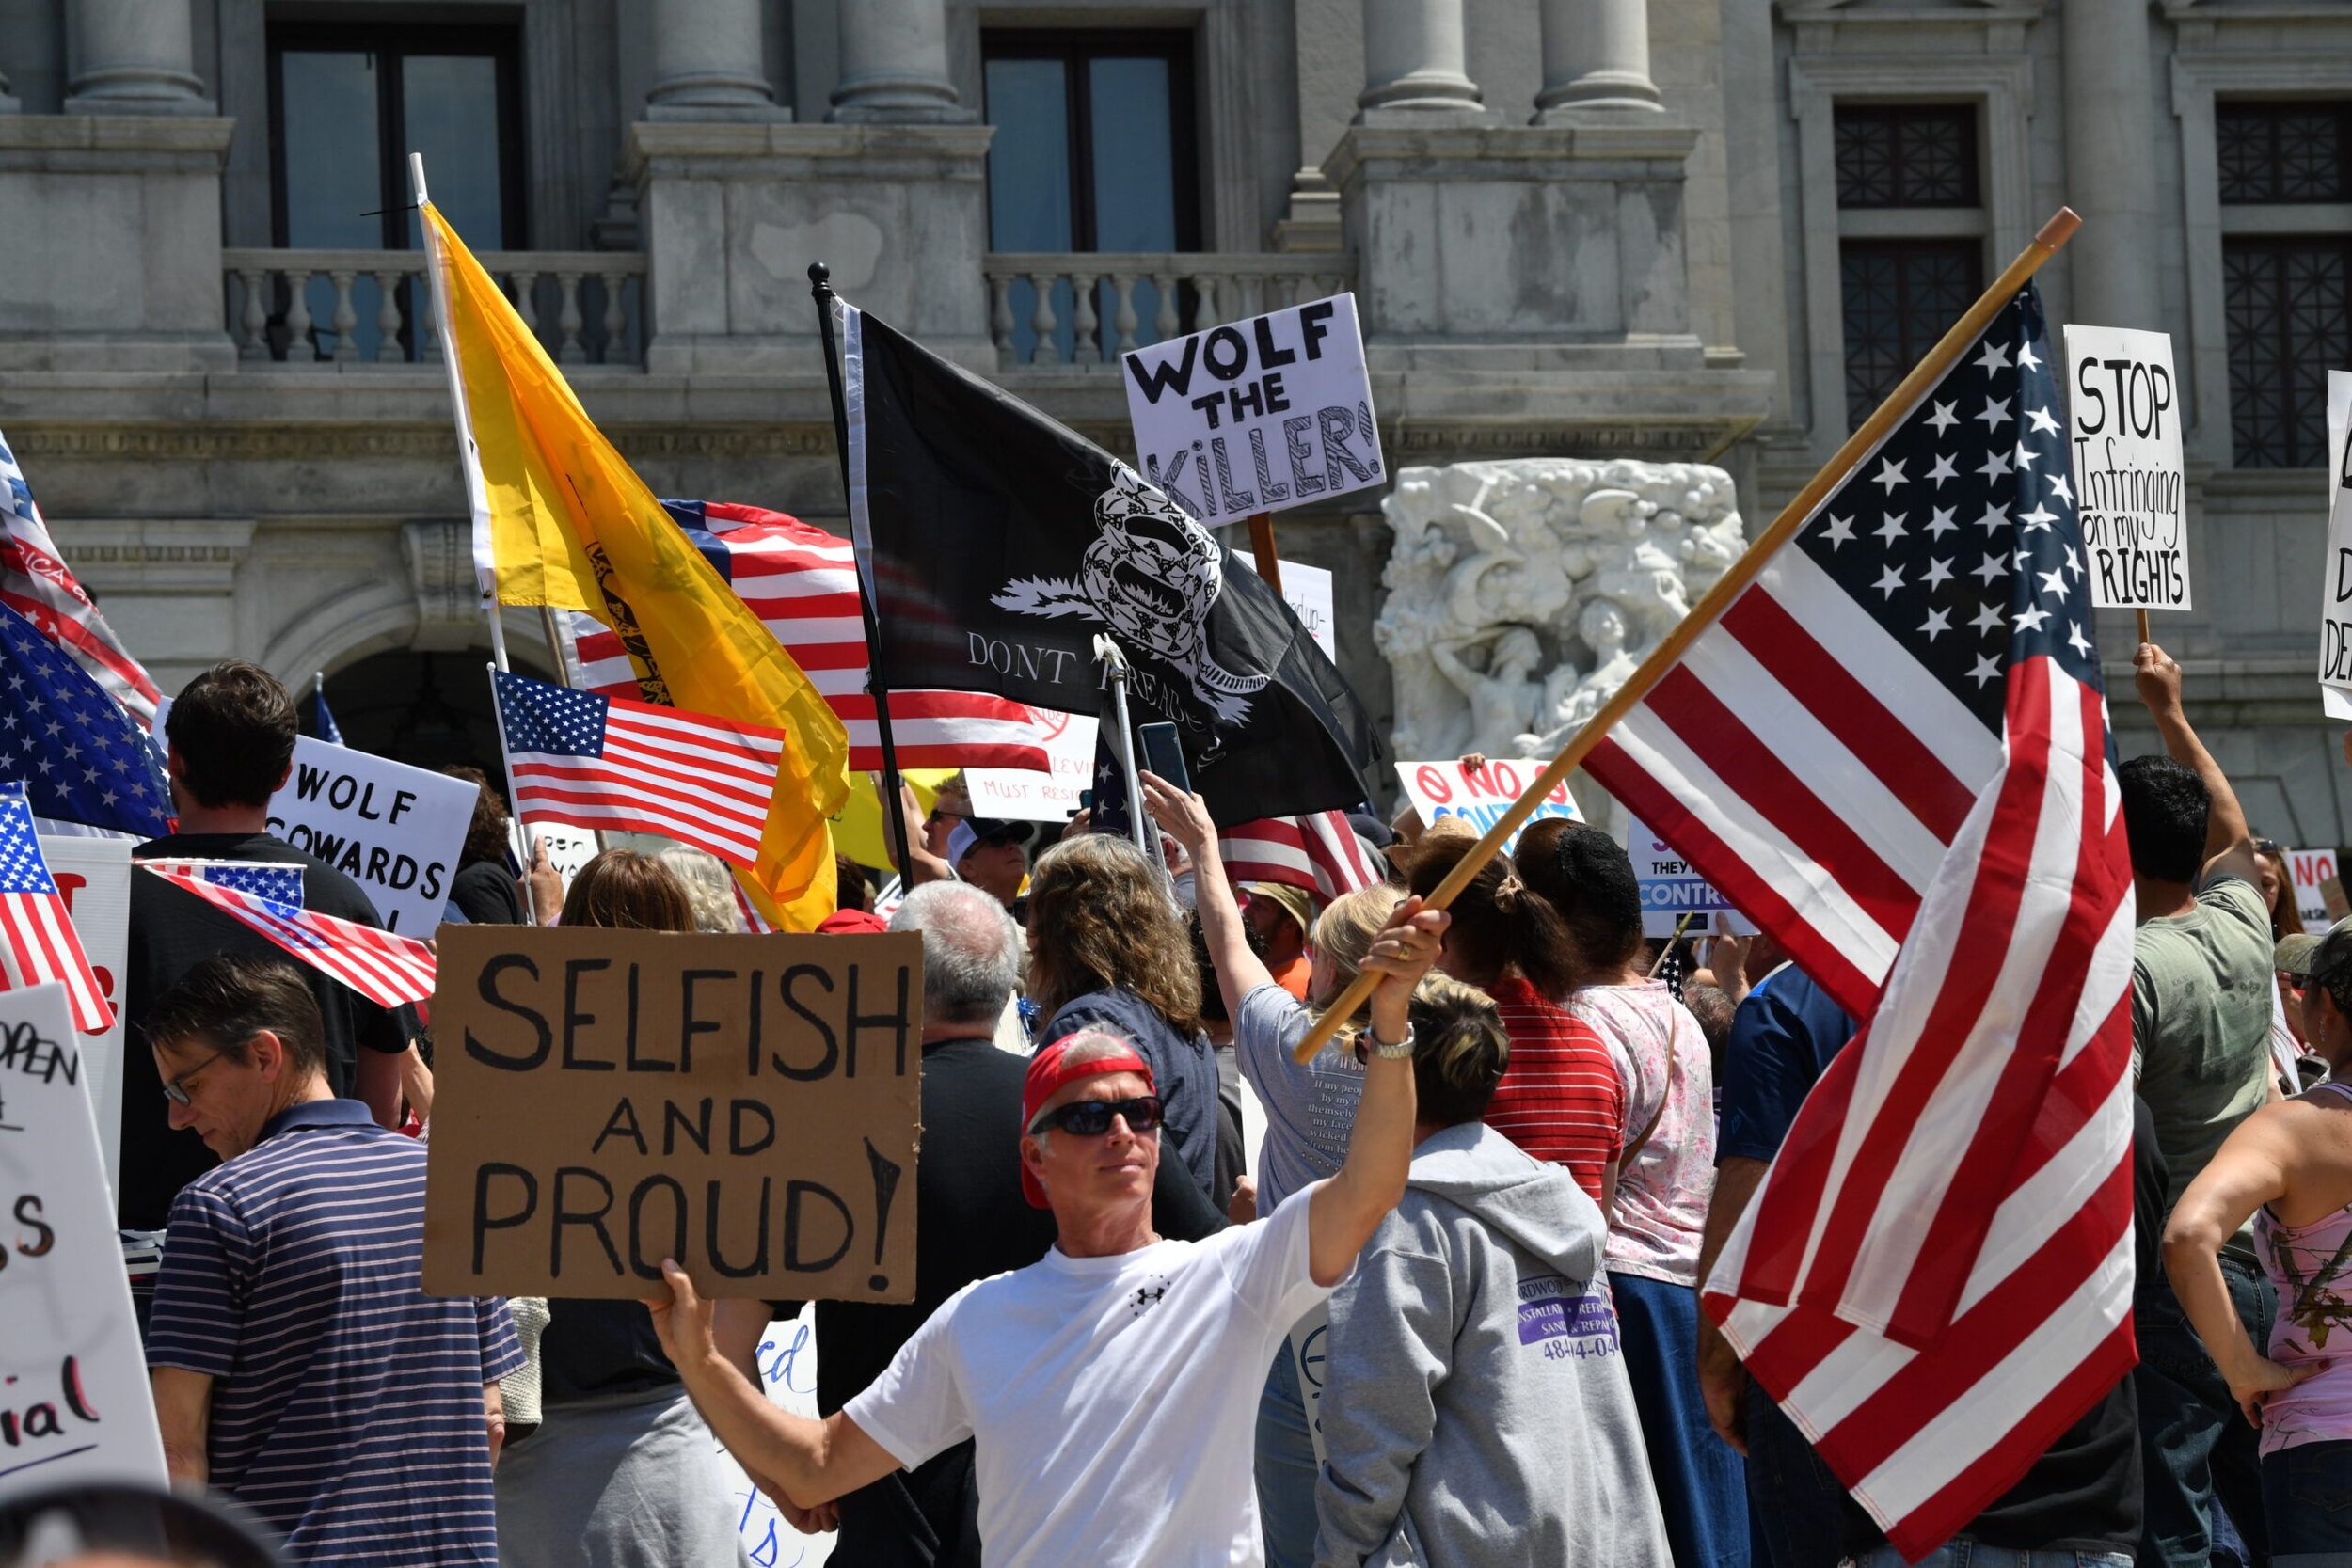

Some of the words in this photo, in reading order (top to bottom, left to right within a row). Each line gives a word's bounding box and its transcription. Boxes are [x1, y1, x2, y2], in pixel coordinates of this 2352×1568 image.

[1126, 301, 1333, 404] WOLF
[1191, 372, 1290, 429] THE
[2077, 357, 2170, 440] STOP
[2074, 437, 2180, 549] Infringing
[2081, 514, 2108, 546] on
[2114, 515, 2139, 557] my
[2096, 548, 2183, 604] RIGHTS
[967, 632, 1077, 685] DONT
[297, 763, 417, 824] WOLF
[984, 780, 1030, 799] MUST
[1457, 760, 1522, 800] NO
[1652, 862, 1688, 875] THEY
[2294, 855, 2333, 887] NO
[464, 953, 911, 1082] SELFISH
[1324, 1083, 1340, 1093] my
[591, 1097, 776, 1156] AND
[472, 1136, 901, 1291] PROUD!
